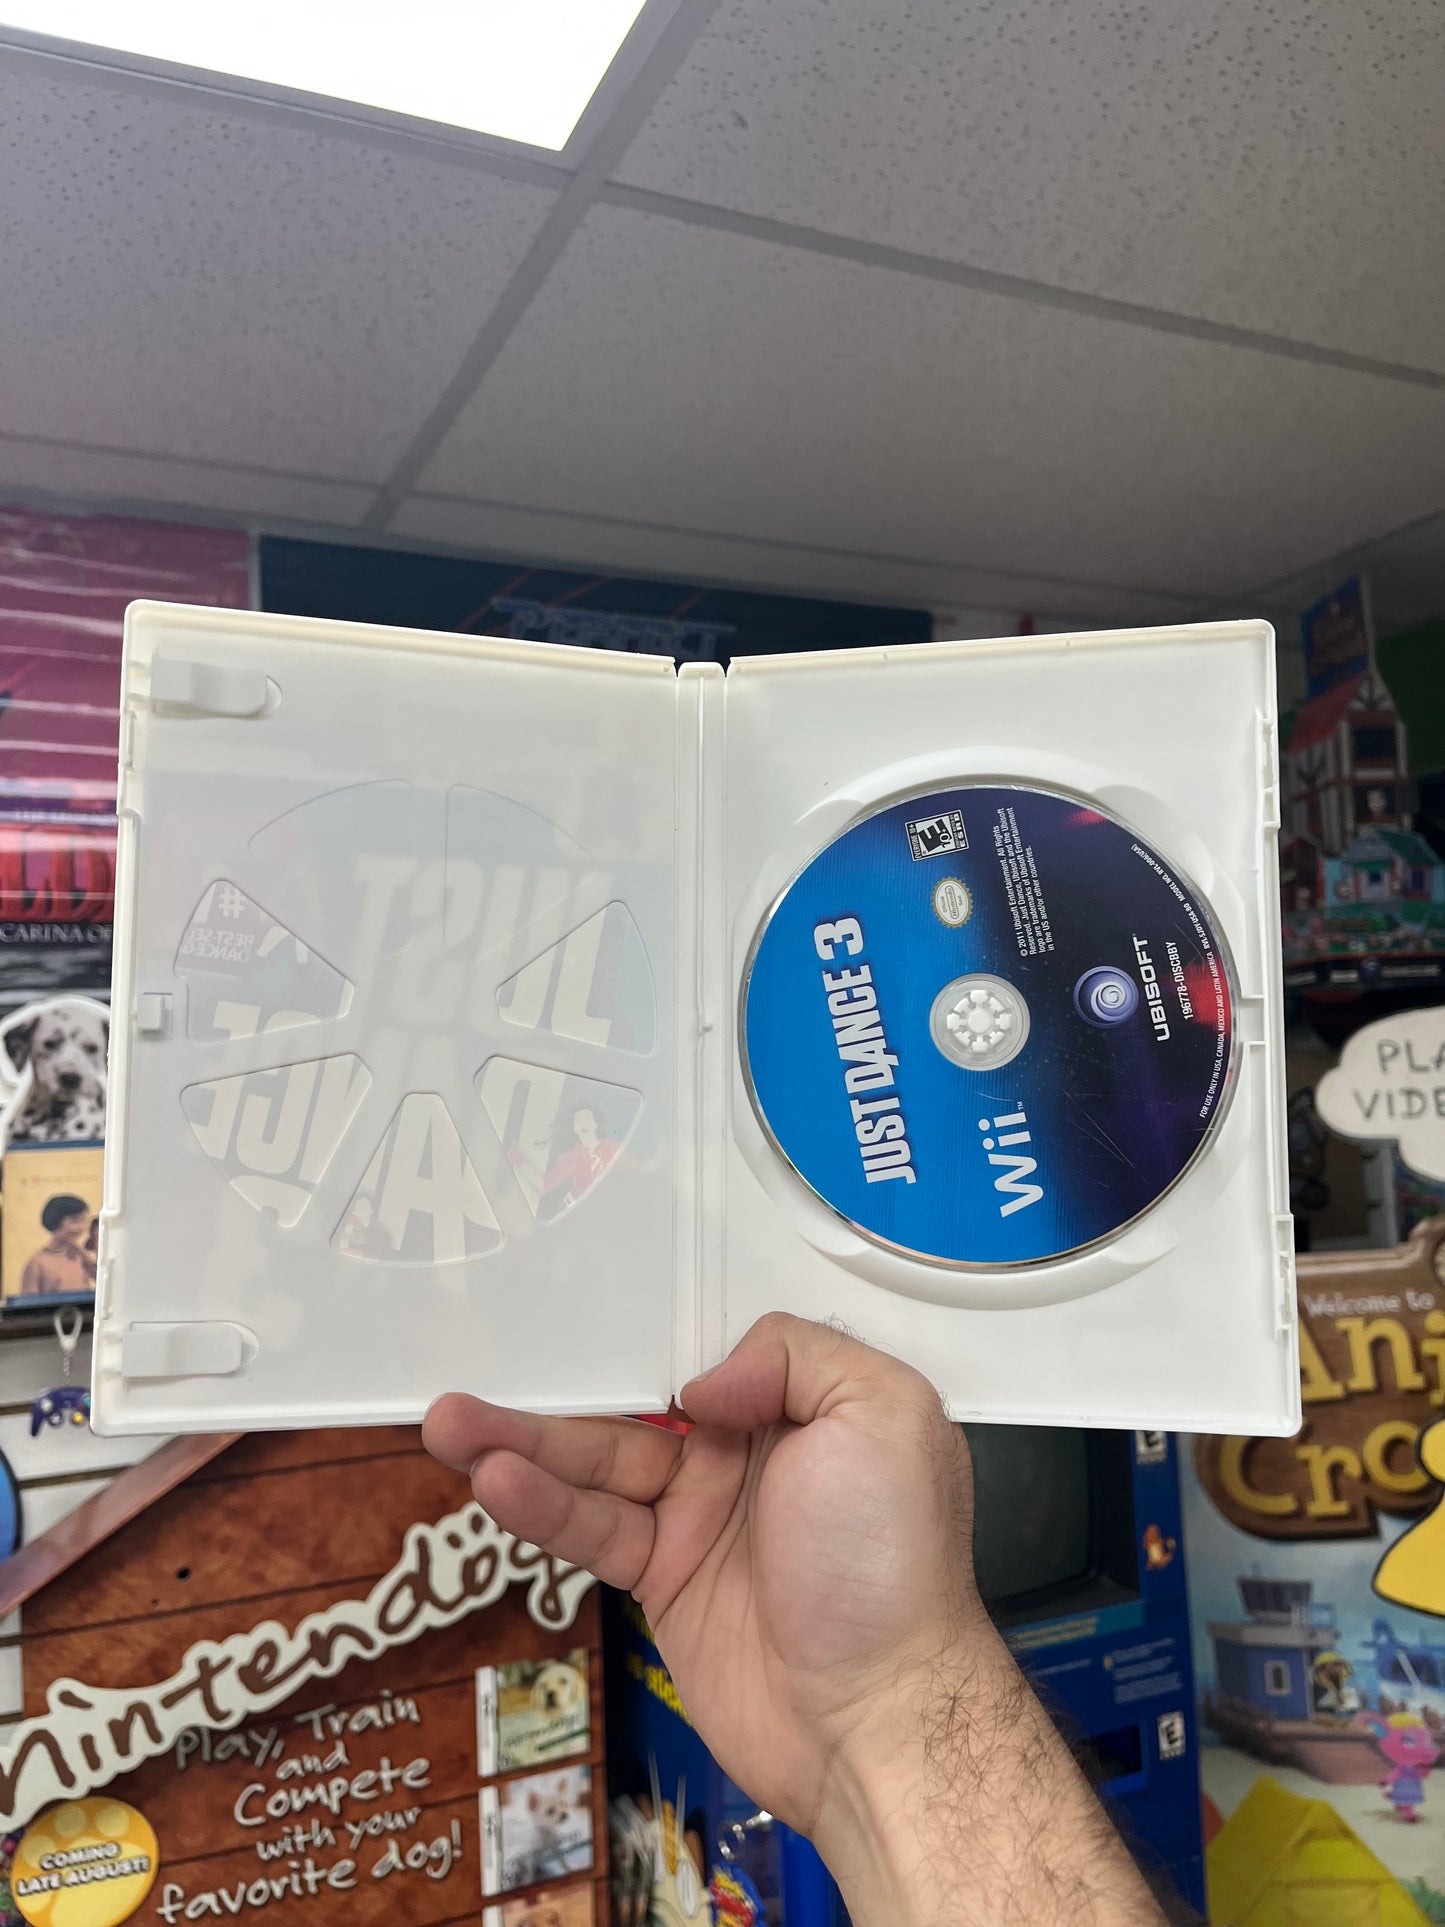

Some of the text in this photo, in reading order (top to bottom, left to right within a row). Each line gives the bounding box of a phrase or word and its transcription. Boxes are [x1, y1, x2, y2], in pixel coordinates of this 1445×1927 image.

[954, 813, 966, 847] ESRB
[992, 825, 1003, 847] Rights
[1007, 807, 1023, 853] Entertainment
[911, 834, 921, 858] EVERYONE
[997, 848, 1005, 856] All
[1017, 854, 1028, 877] Ubisoft
[1025, 845, 1038, 877] countries.
[997, 808, 1037, 954] Reserved. Just Dance, Ubisoft and the Ubisoft
[1000, 858, 1016, 905] Entertainment.
[1031, 879, 1042, 896] other
[1162, 873, 1173, 882] NO.
[947, 888, 957, 916] Nintendo
[1170, 882, 1185, 901] MODEL
[1025, 886, 1039, 924] trademarks
[1035, 898, 1048, 919] and/or
[1010, 906, 1023, 930] Ubisoft
[1041, 920, 1050, 930] US
[1016, 931, 1026, 948] 2011
[1032, 926, 1041, 937] are
[1043, 932, 1052, 942] the
[1036, 938, 1046, 953] logo
[1206, 951, 1219, 977] AMERICA
[1133, 937, 1170, 1041] UBISOFT
[1165, 941, 1195, 1020] 196778-DISCBBY
[1214, 978, 1223, 993] LATIN
[813, 918, 916, 1184] JUST DANCE 3
[1216, 1032, 1226, 1057] CANADA,
[1214, 1058, 1223, 1071] USA,
[1207, 1078, 1218, 1094] ONLY
[1199, 1106, 1209, 1118] FOR
[1204, 1095, 1214, 1105] USE
[1302, 1288, 1435, 1318] Welcome to
[295, 1689, 421, 1741] Train
[275, 1740, 350, 1780] and
[234, 1756, 432, 1826] Compete
[256, 1805, 422, 1860] with your
[40, 1841, 120, 1871] COMING
[17, 1855, 151, 1896] LATE AUGUST!
[156, 1858, 358, 1924] favorite
[371, 1818, 463, 1879] dog!
